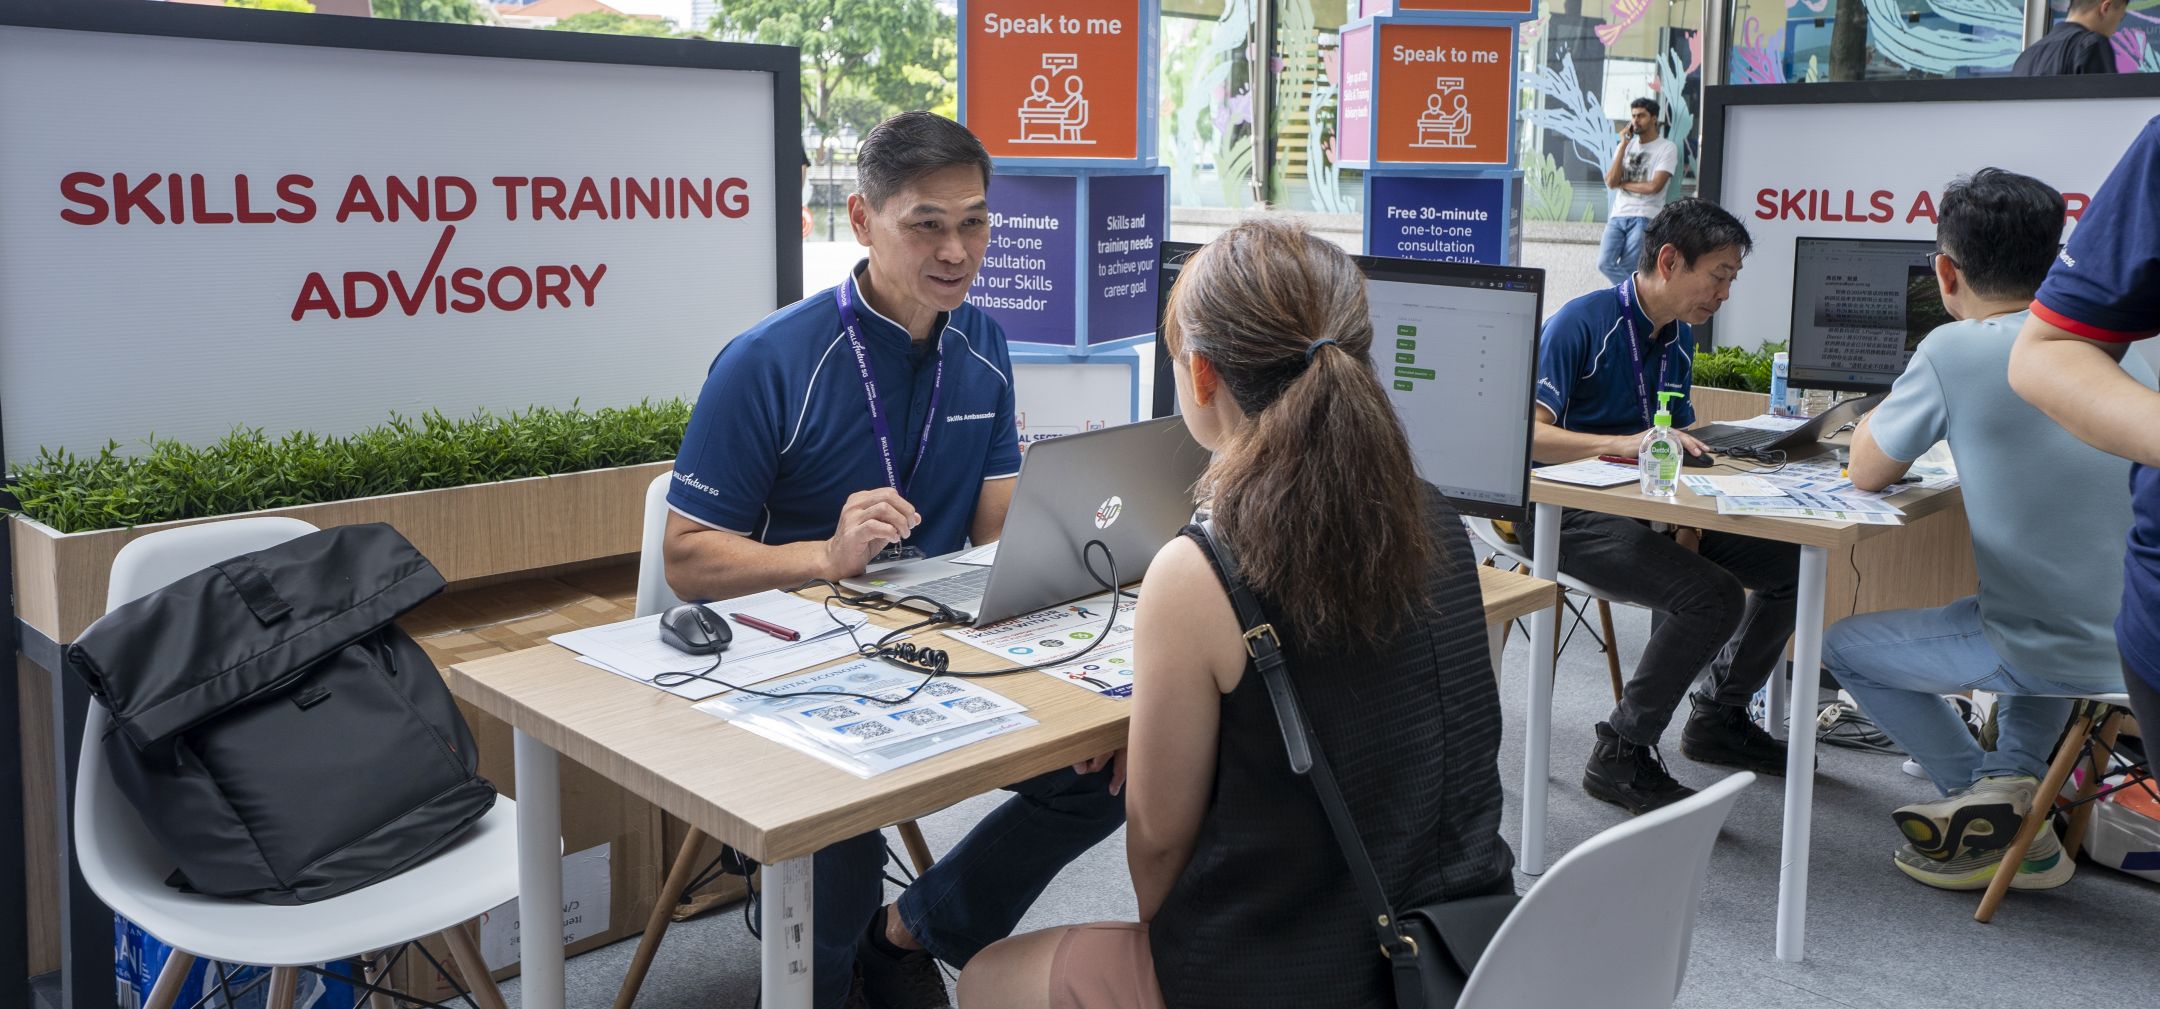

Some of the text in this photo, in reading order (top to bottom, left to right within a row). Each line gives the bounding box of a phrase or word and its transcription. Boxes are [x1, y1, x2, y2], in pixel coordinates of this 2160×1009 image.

[984, 13, 1122, 38] Speak to me
[1393, 45, 1499, 65] Speak to me
[60, 172, 750, 226] SKILLS AND TRAINING
[1755, 188, 1894, 223] SKILLS
[1107, 213, 1146, 231] Skills and
[1387, 206, 1488, 221] Free 30-minute
[1401, 224, 1473, 237] one-to-one
[1097, 235, 1154, 255] training needs
[1397, 239, 1475, 254] consultation
[291, 225, 607, 321] ADVISORY
[1098, 259, 1155, 277] to achieve your
[988, 276, 1012, 289] our
[1014, 273, 1053, 292] Skills
[1104, 278, 1147, 298] career goal
[963, 291, 1048, 312] Ambassador
[946, 412, 996, 423] Skills Ambassador
[880, 436, 890, 457] SKILLS
[709, 488, 720, 497] SG
[1022, 609, 1061, 623] YOUR
[967, 625, 1013, 639] SKILLS
[1014, 616, 1050, 630] WITH
[810, 661, 868, 683] ECONOMY
